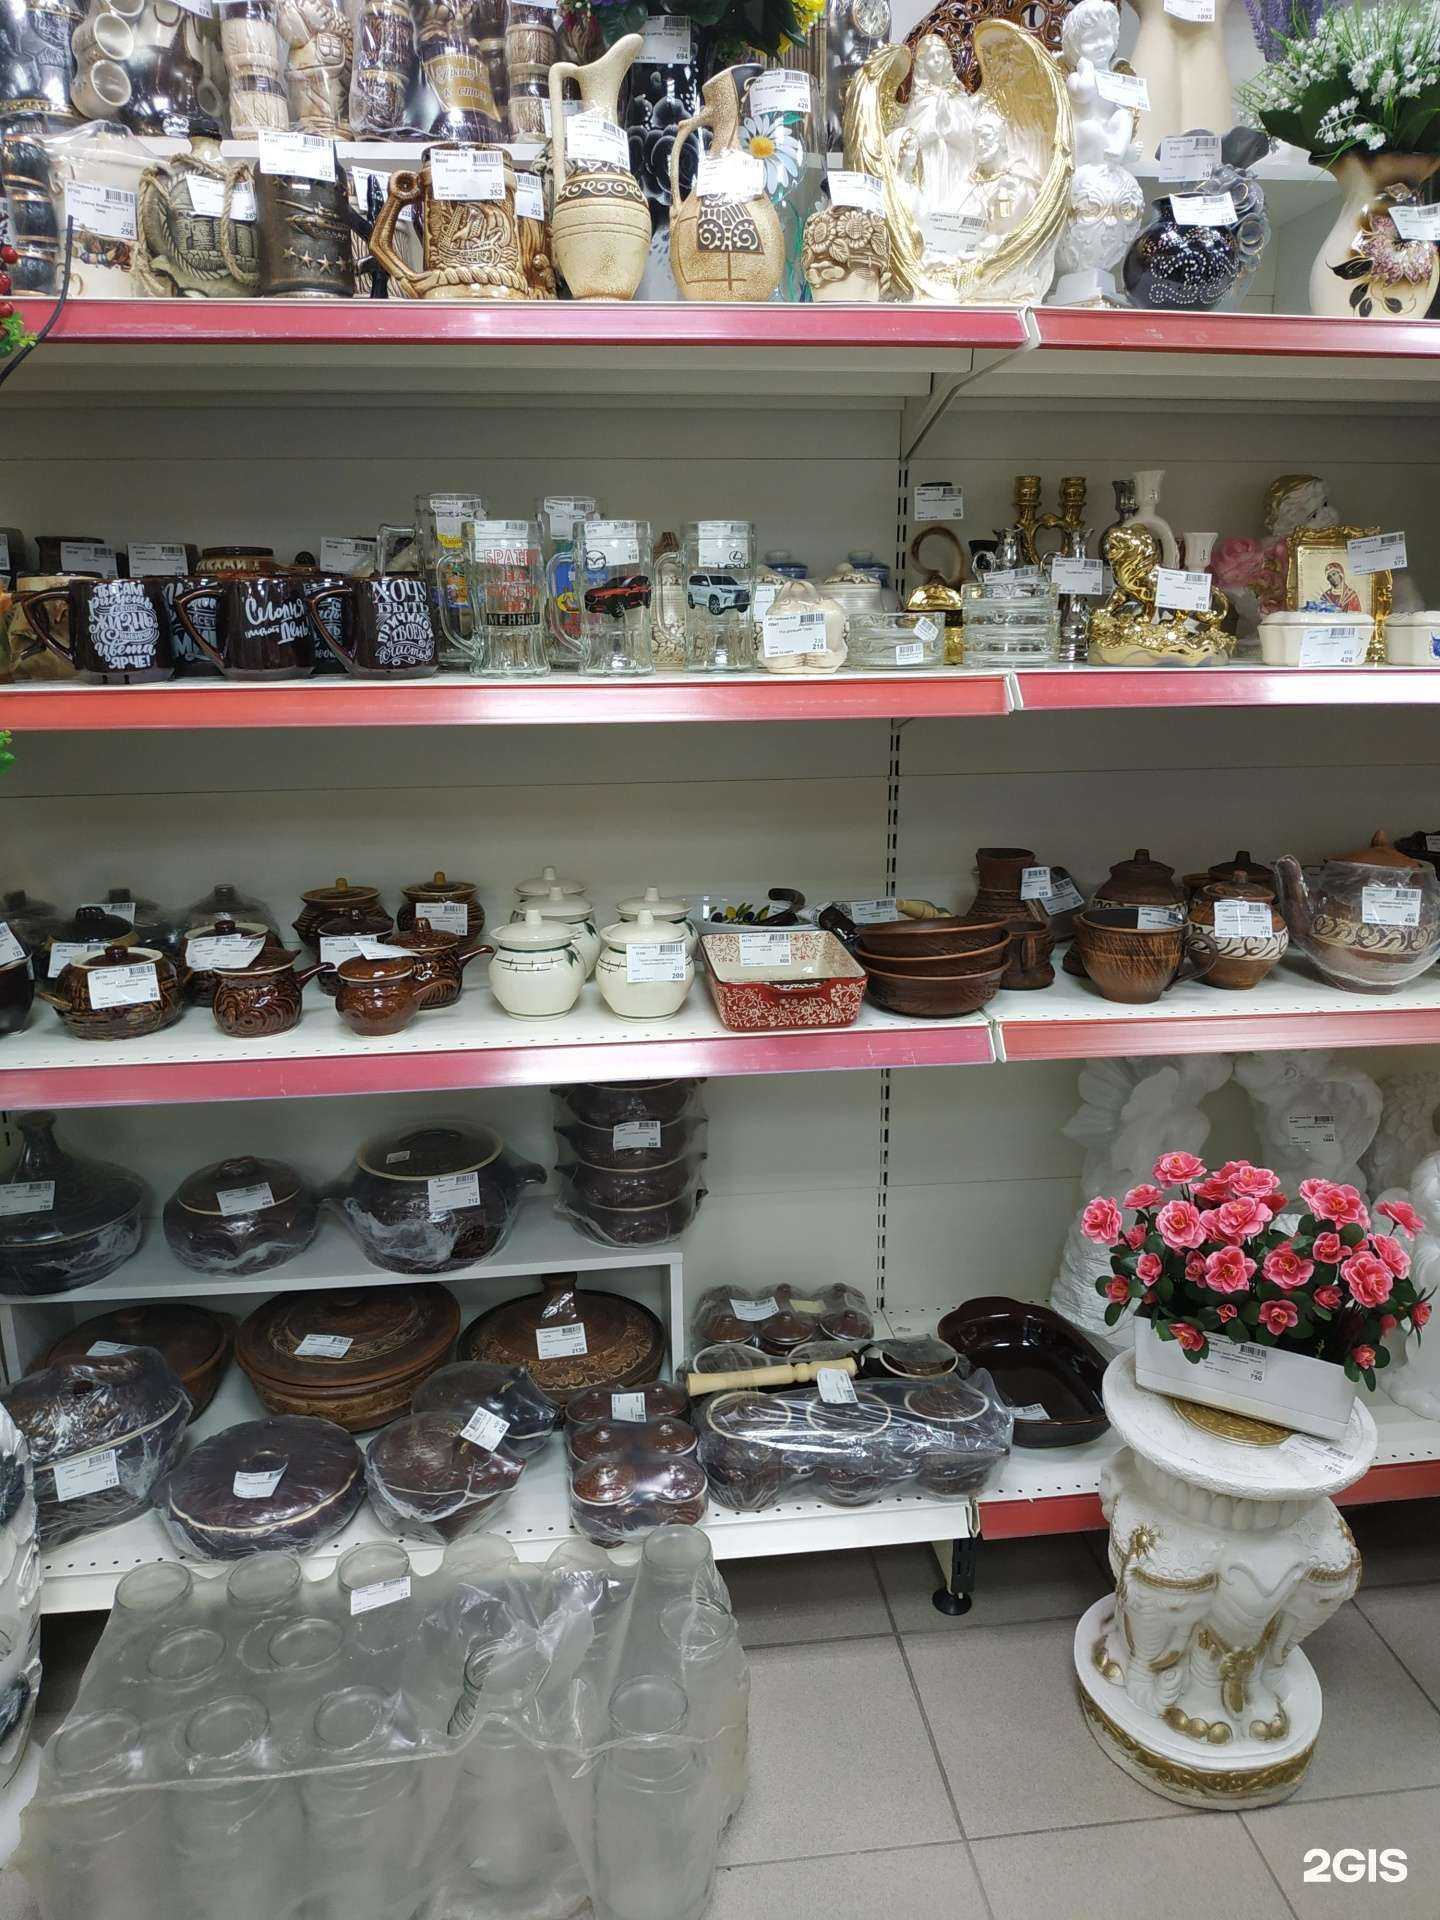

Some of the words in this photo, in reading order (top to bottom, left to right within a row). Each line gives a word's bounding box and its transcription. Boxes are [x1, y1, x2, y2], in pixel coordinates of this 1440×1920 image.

[370, 579, 427, 604] ХОЧУ
[378, 602, 430, 614] БЫТЬ
[108, 655, 152, 669] ЯРЧЕ!
